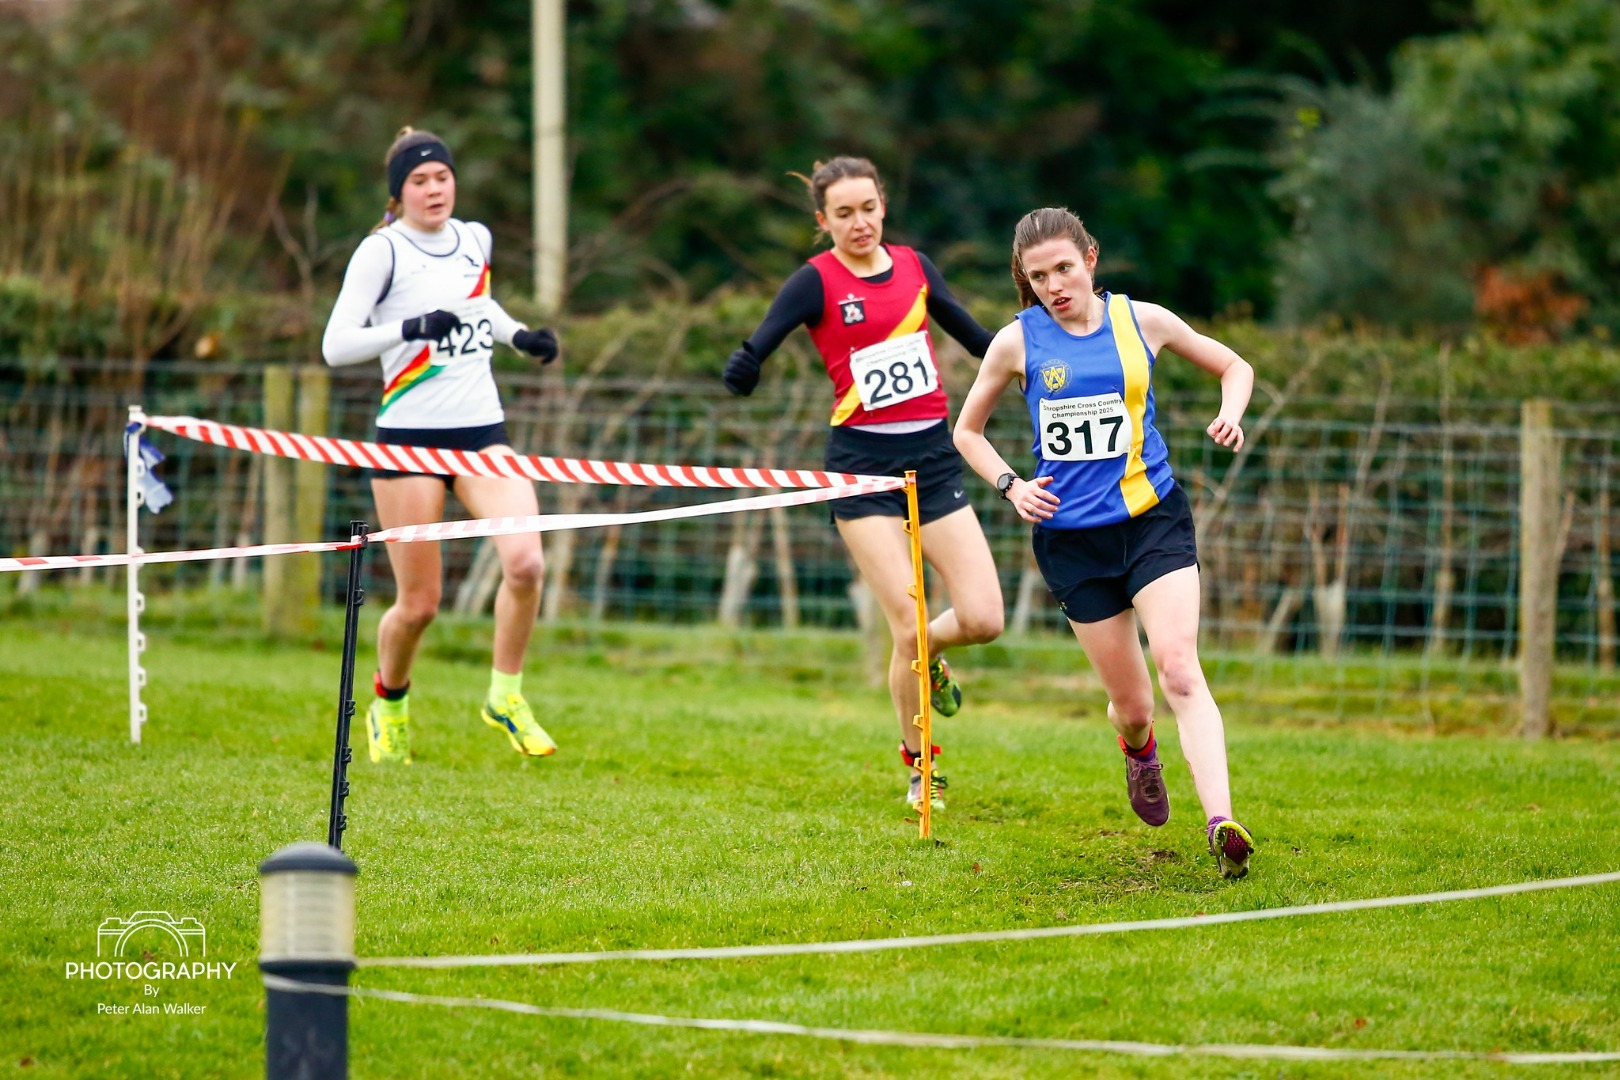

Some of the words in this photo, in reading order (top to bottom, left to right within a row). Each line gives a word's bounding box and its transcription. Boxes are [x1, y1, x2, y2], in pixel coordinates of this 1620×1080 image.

[437, 319, 492, 357] 423
[864, 356, 928, 404] 281
[1043, 402, 1076, 412] Shropshire
[1077, 401, 1097, 409] Cross
[1097, 398, 1123, 407] Country
[1051, 408, 1098, 419] Championship
[1046, 415, 1124, 455] 317
